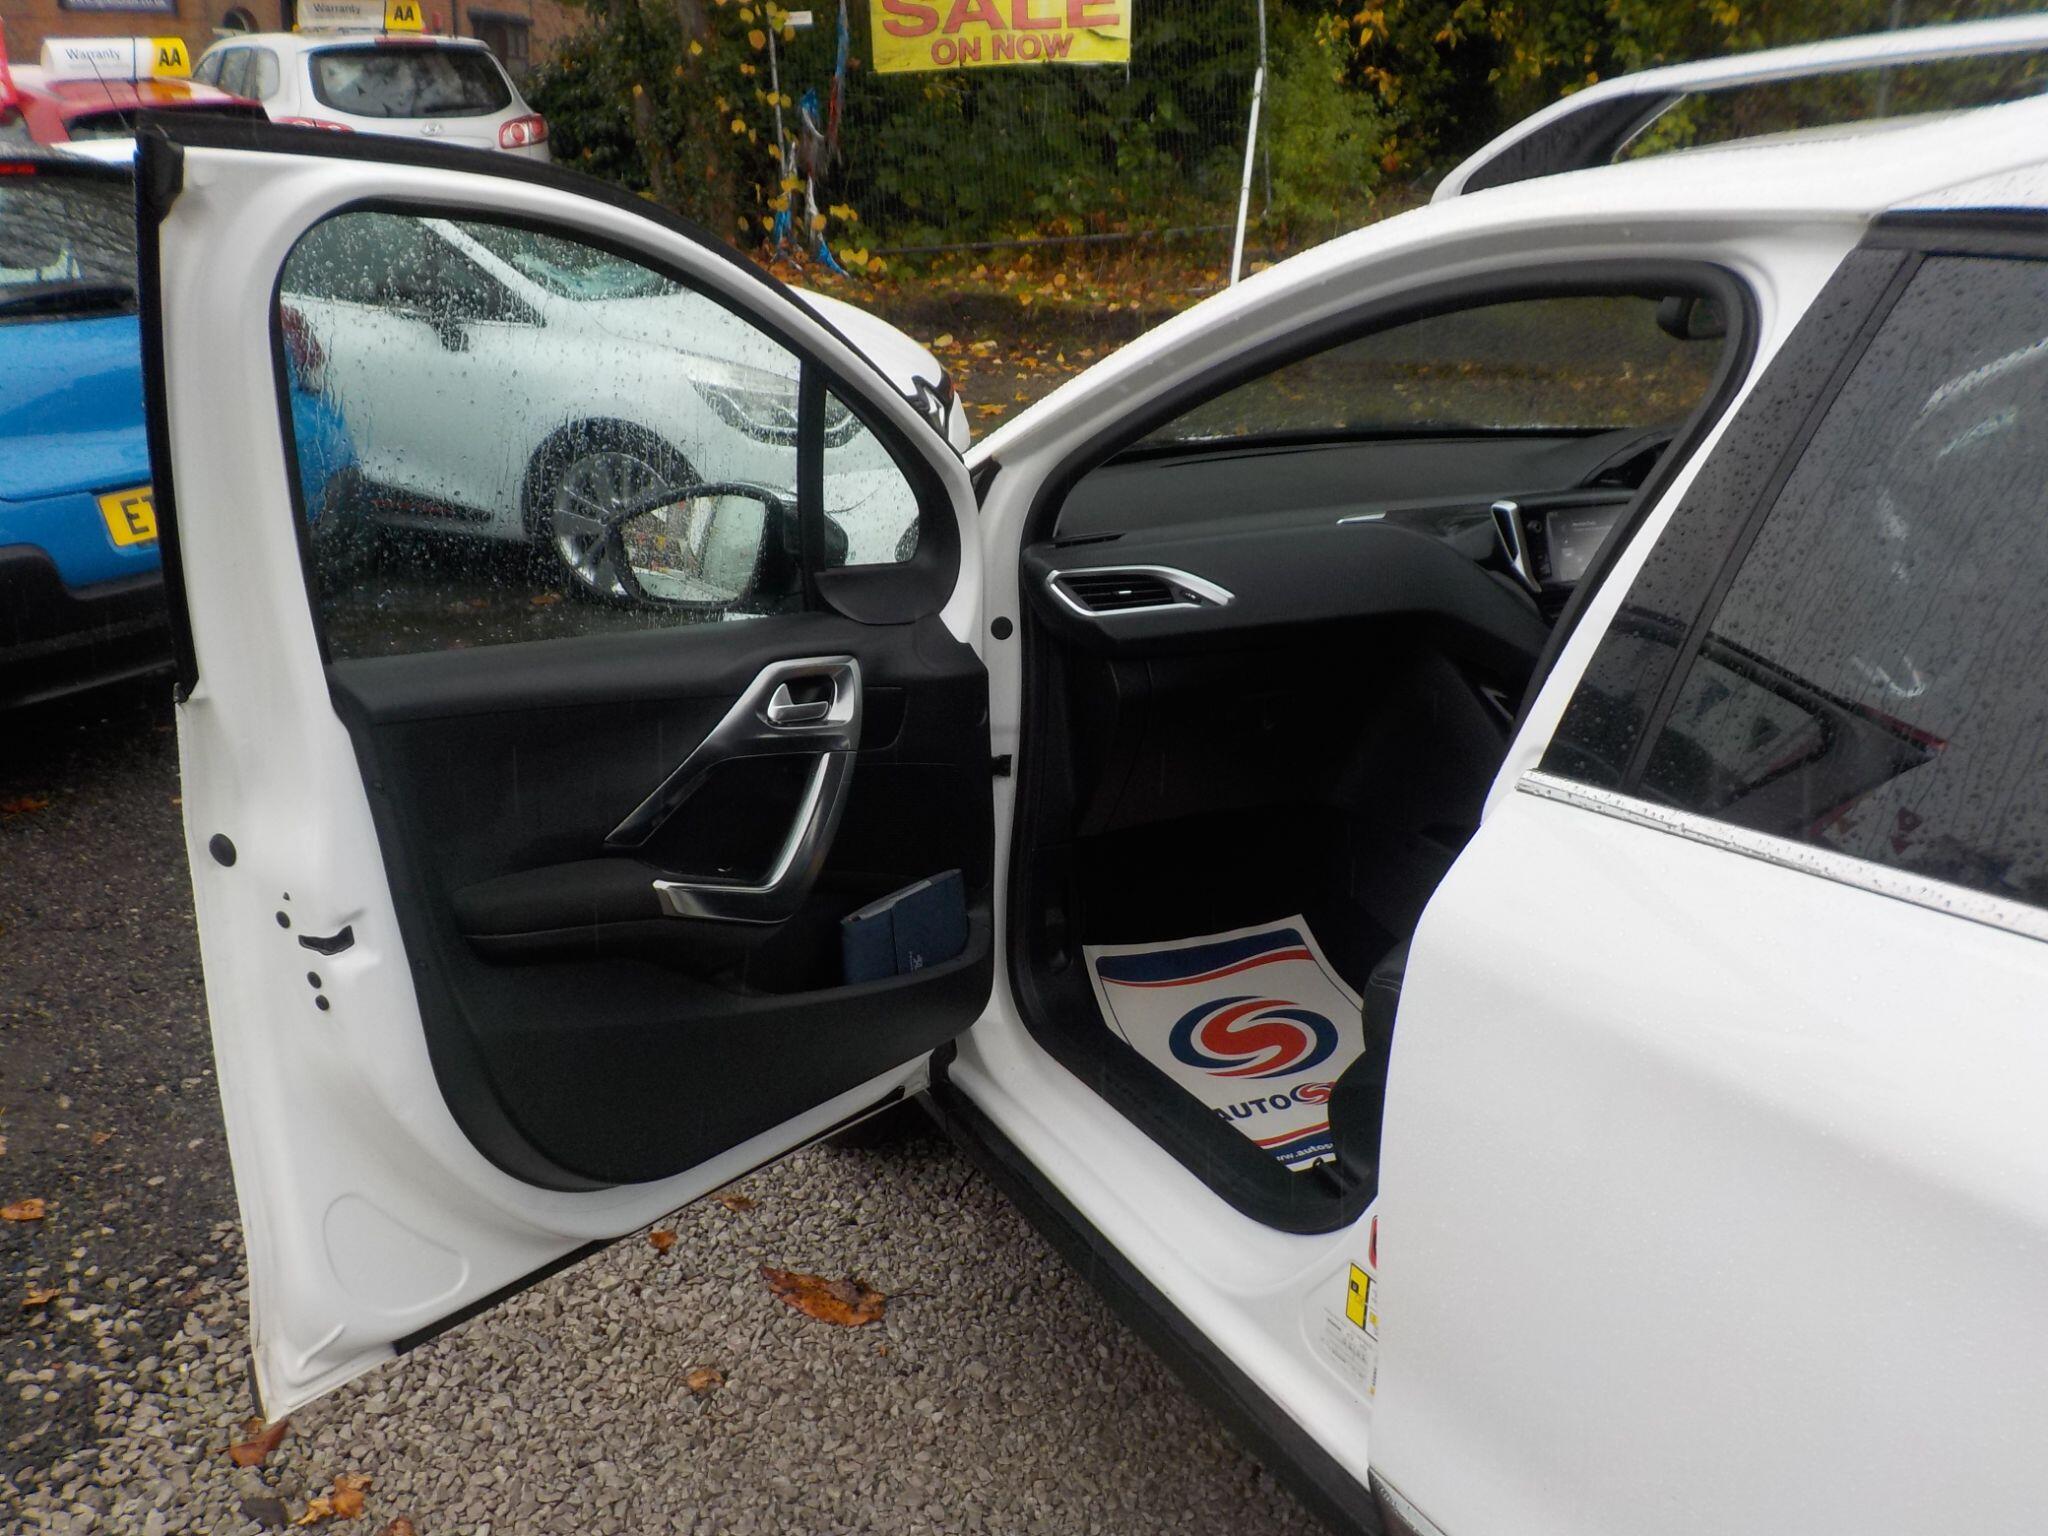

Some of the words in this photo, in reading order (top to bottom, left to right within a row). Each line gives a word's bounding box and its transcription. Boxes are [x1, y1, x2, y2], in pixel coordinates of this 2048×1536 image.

[313, 3, 360, 15] Warranty
[394, 5, 414, 21] AA
[66, 48, 120, 61] Warranty
[159, 47, 182, 67] AA
[931, 37, 981, 65] ON
[992, 33, 1074, 61] NOW
